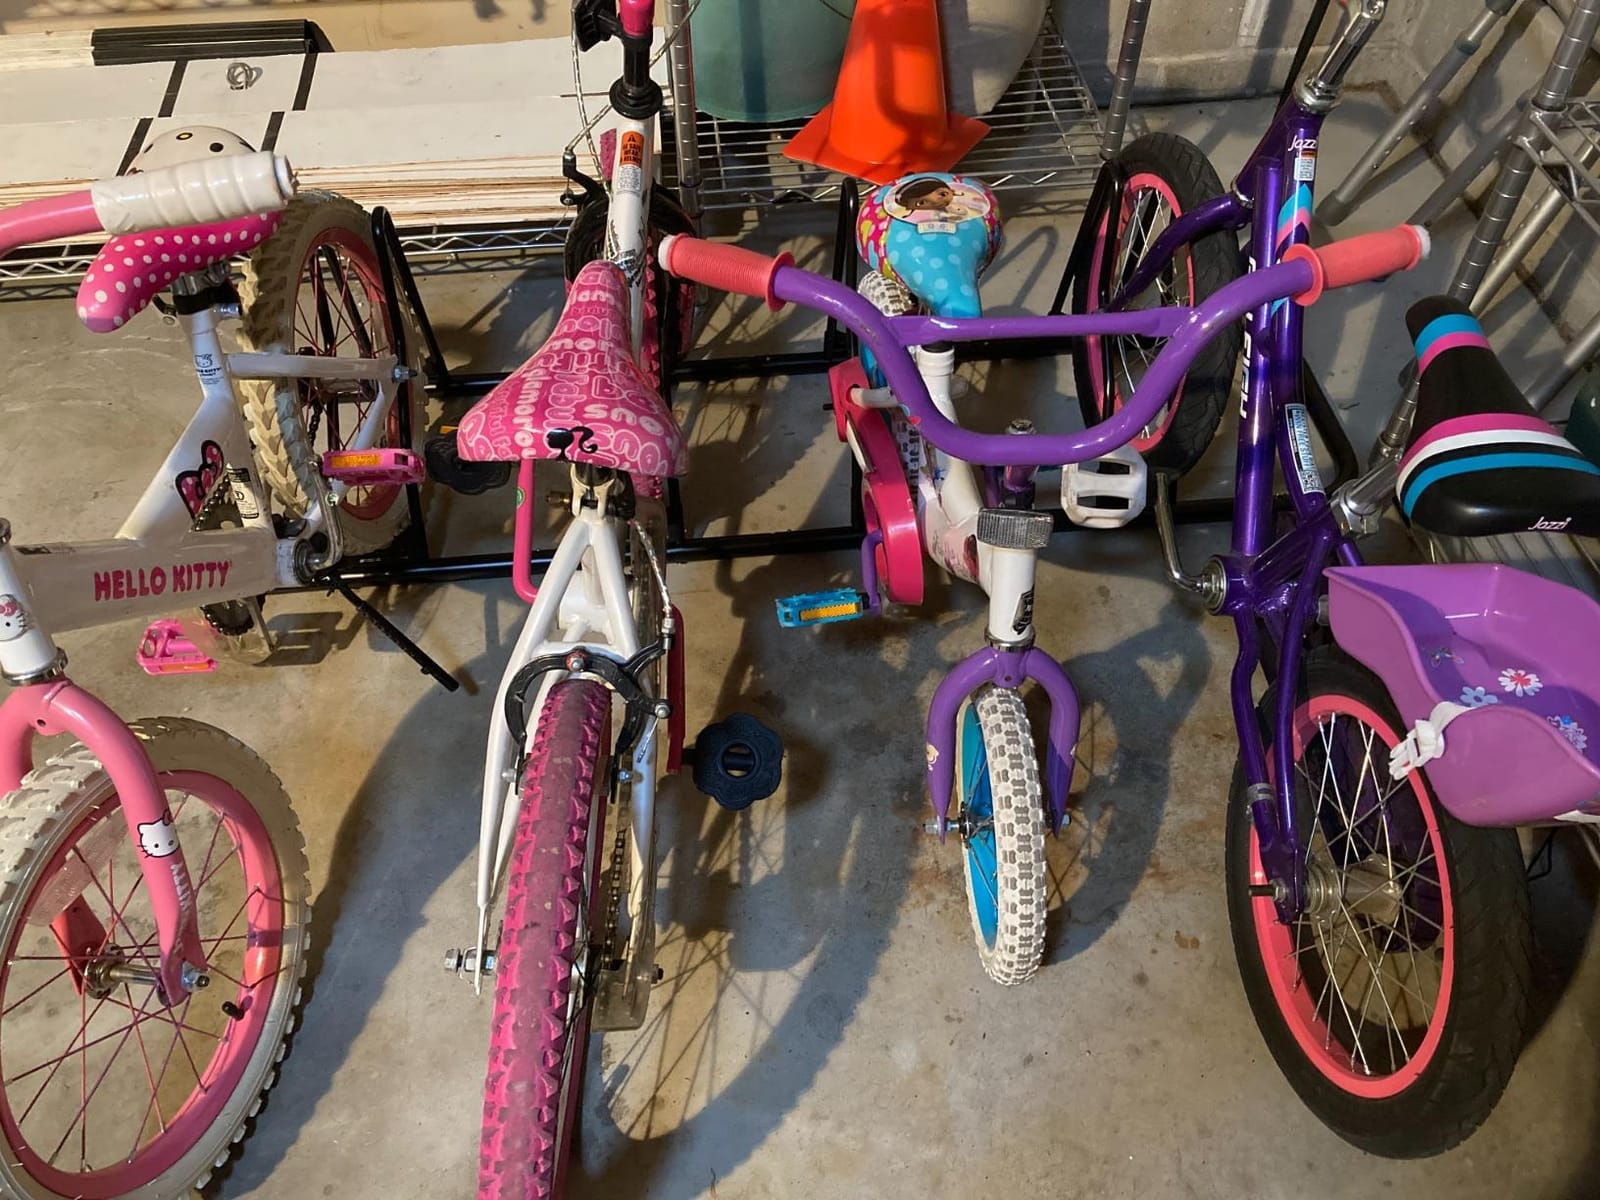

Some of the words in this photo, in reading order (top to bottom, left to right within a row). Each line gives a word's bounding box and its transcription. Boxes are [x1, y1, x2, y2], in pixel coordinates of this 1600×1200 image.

[1527, 516, 1572, 531] Jazzi
[94, 566, 167, 602] HELLO
[172, 560, 229, 593] KITTY
